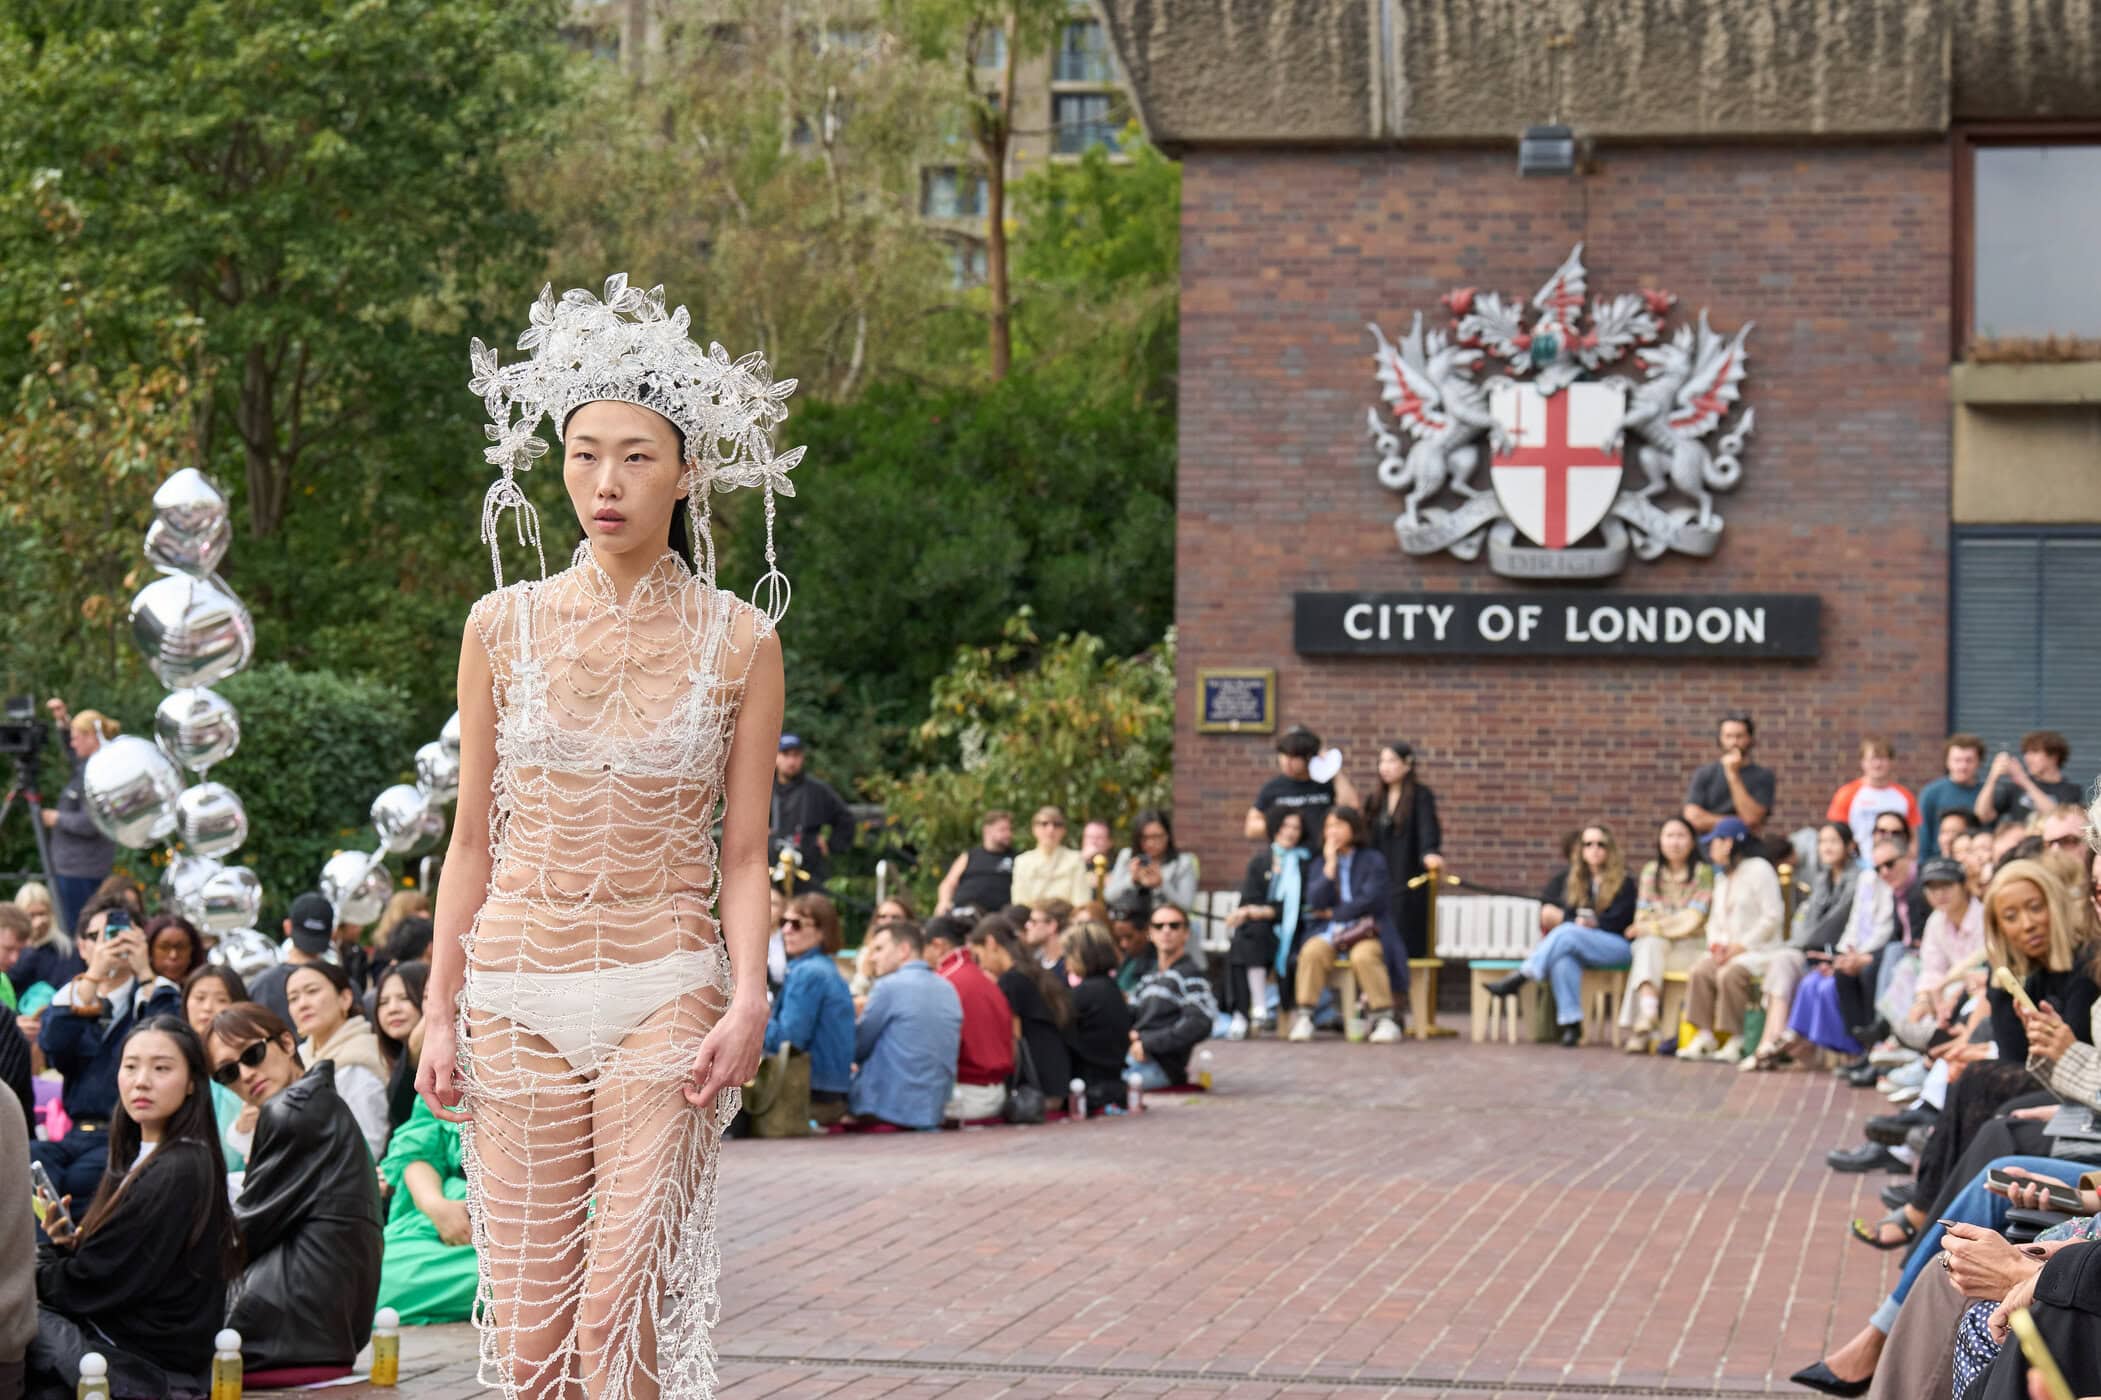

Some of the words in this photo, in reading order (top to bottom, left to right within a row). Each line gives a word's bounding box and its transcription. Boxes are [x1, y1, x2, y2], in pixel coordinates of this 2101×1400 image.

[1343, 603, 1454, 641] CITY
[1478, 604, 1542, 642] OF
[1565, 606, 1766, 644] LONDON
